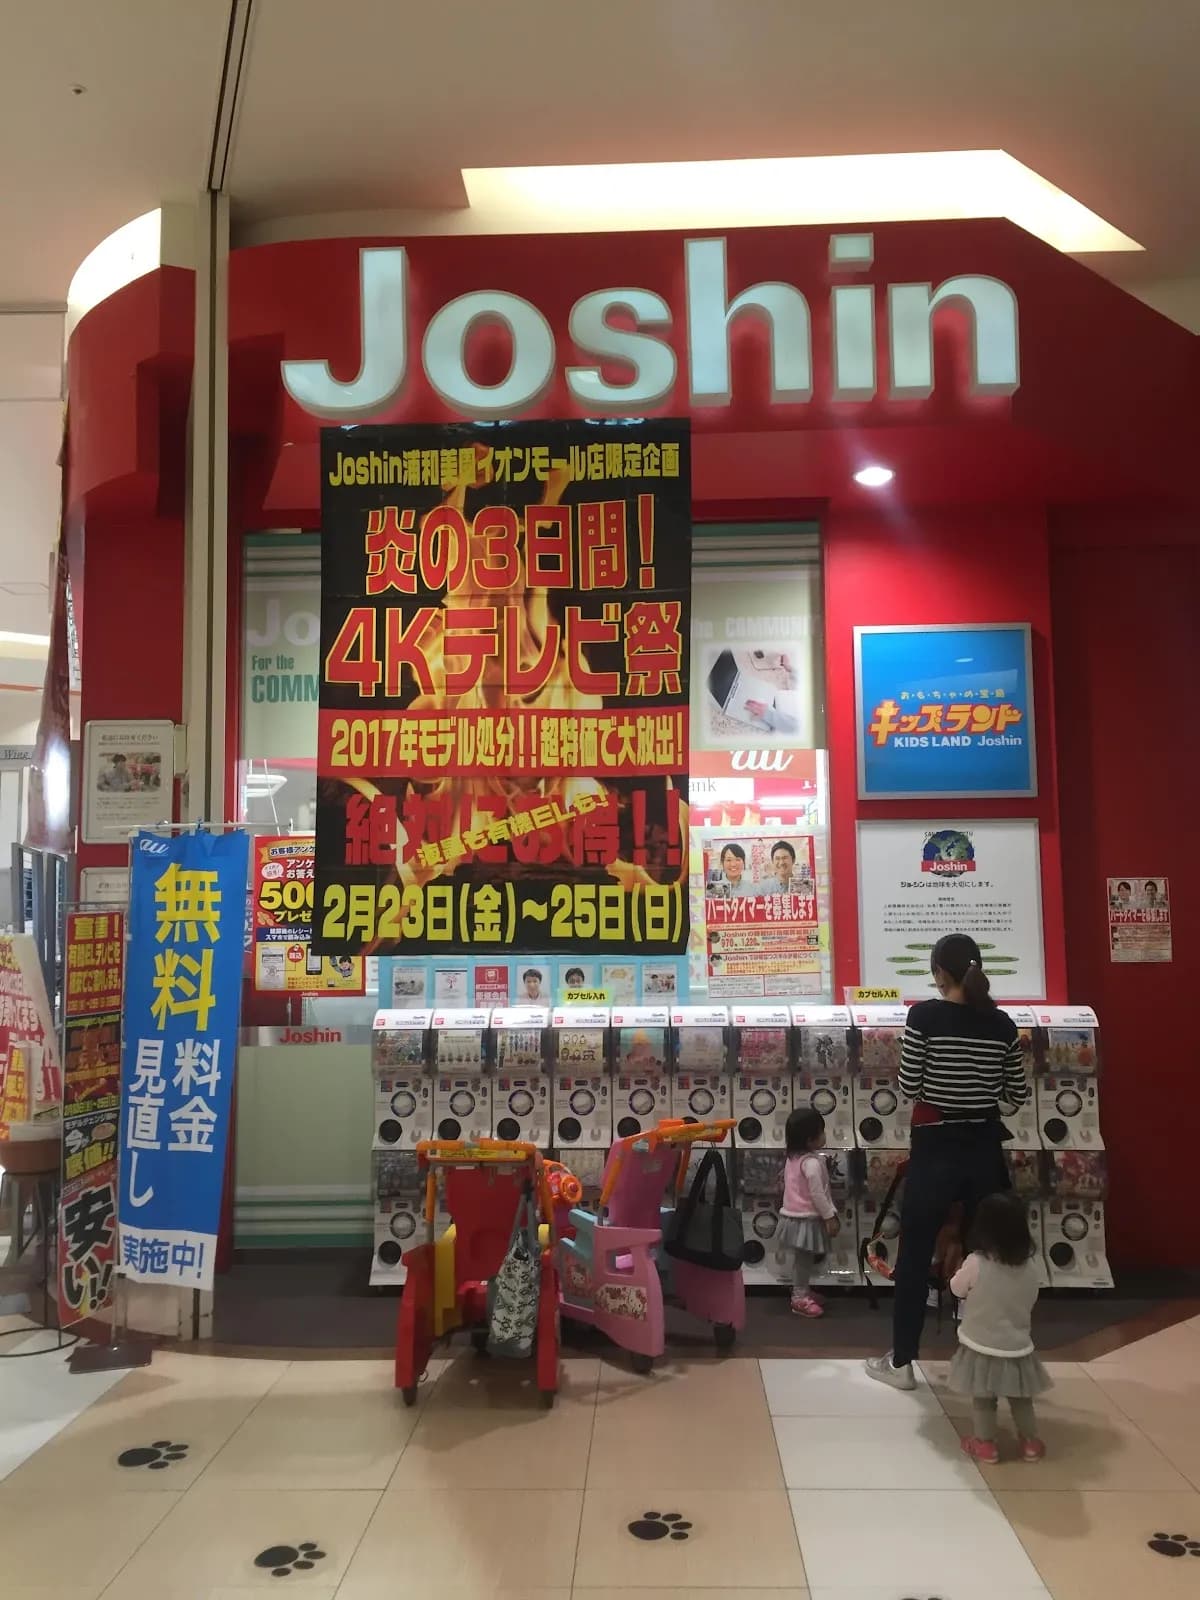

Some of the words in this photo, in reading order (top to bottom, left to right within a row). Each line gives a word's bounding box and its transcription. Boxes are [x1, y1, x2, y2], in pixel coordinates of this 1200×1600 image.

[280, 232, 1020, 418] Joshin
[328, 442, 681, 486] Joshin浦和美園イオンモール店限定企画
[364, 493, 656, 596] 炎の3日間!
[252, 655, 272, 671] For
[276, 654, 295, 670] the
[324, 601, 683, 698] 4Kテレビ祭
[330, 714, 684, 768] 2017年モデル処分!!超特価で大放出!
[870, 699, 1023, 746] キッズランド
[894, 736, 930, 748] KIDS
[931, 736, 972, 747] LAND
[977, 735, 1023, 746] Joshin
[929, 861, 968, 872] Joshin
[150, 863, 222, 1031] 無料
[858, 990, 898, 998] カプセル入れ
[280, 1028, 341, 1043] Joshin
[168, 1039, 221, 1153] 料金
[126, 1039, 166, 1208] 見直し
[123, 1234, 204, 1279] 実施中!
